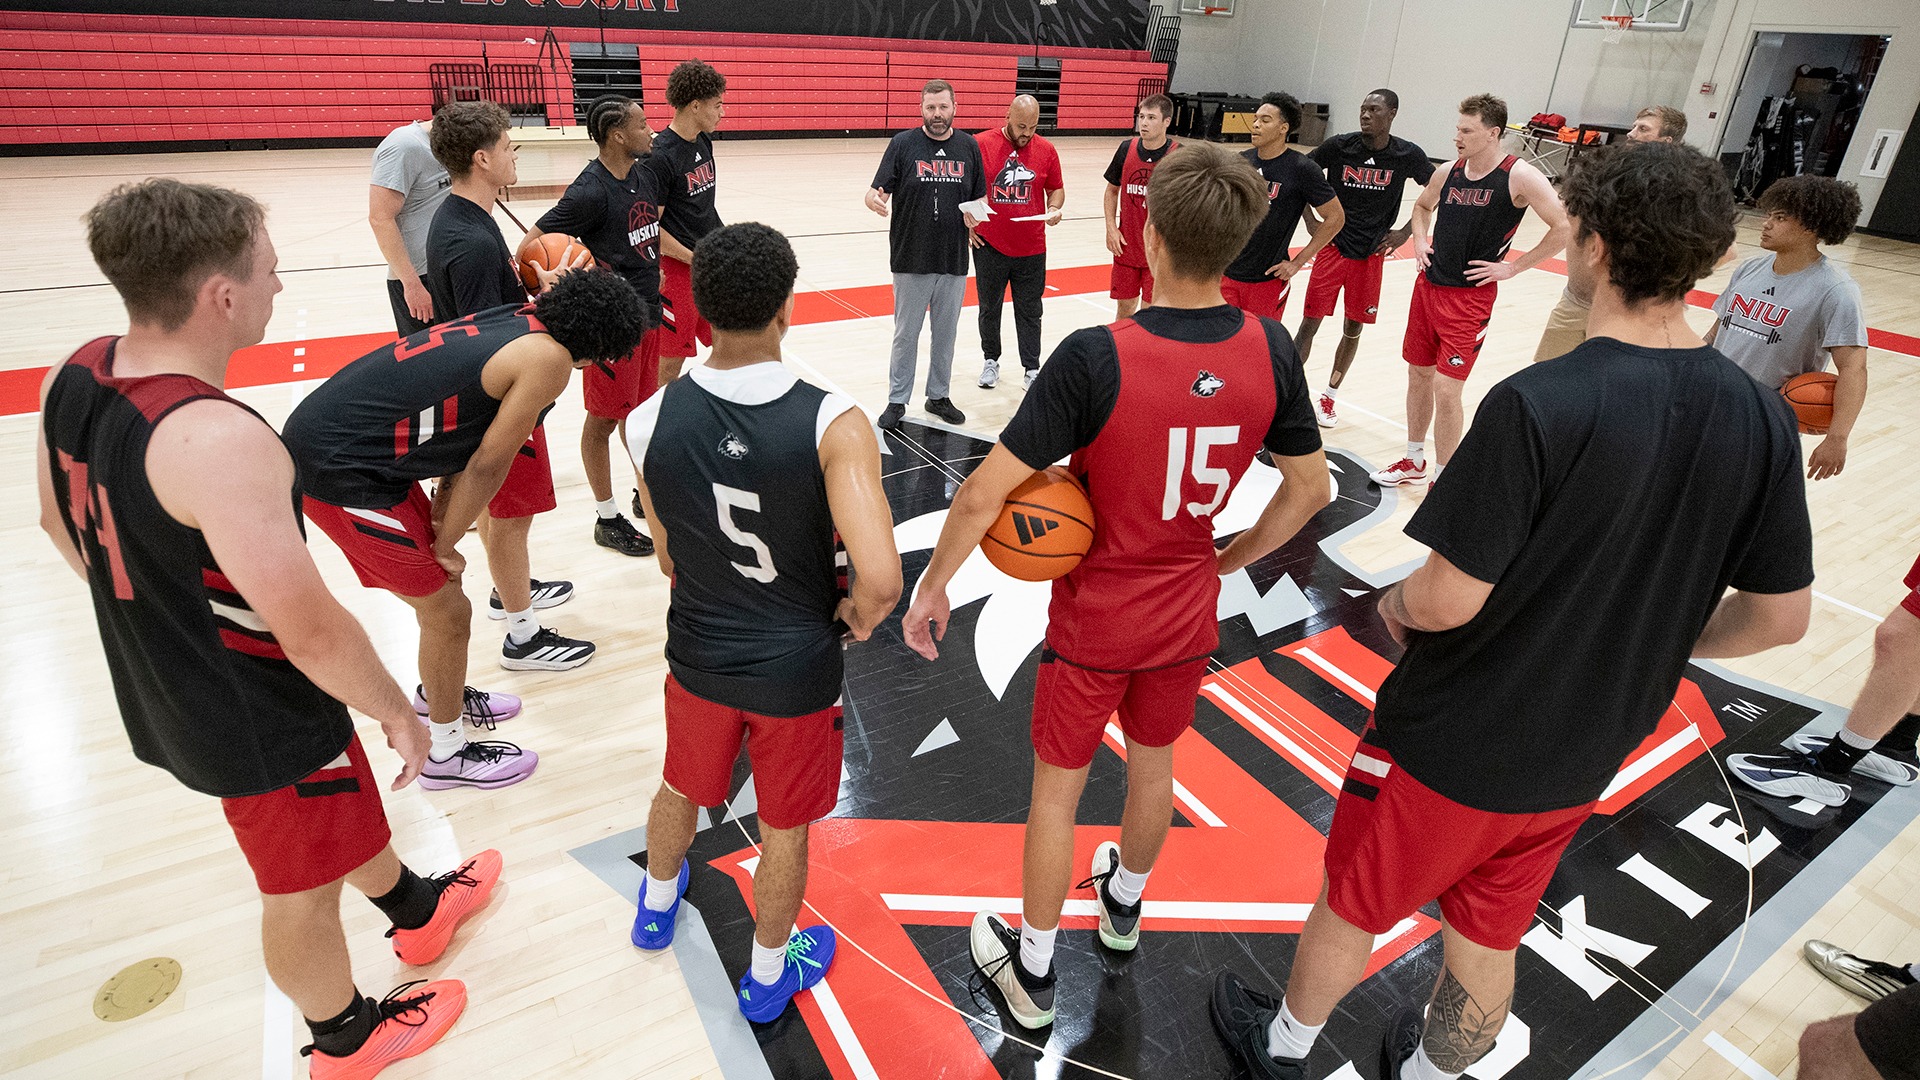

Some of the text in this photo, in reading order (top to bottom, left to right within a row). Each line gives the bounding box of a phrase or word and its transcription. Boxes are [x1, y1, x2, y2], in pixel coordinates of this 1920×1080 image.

[685, 160, 715, 193] NIU
[915, 160, 965, 178] NIU
[1343, 165, 1394, 186] NIU
[1343, 182, 1385, 191] BASKETBALL
[1445, 186, 1494, 207] NIU
[647, 245, 656, 260] 0
[1728, 293, 1792, 328] NIU
[1162, 425, 1241, 521] 15
[711, 483, 779, 583] 5
[1721, 697, 1768, 722] TM
